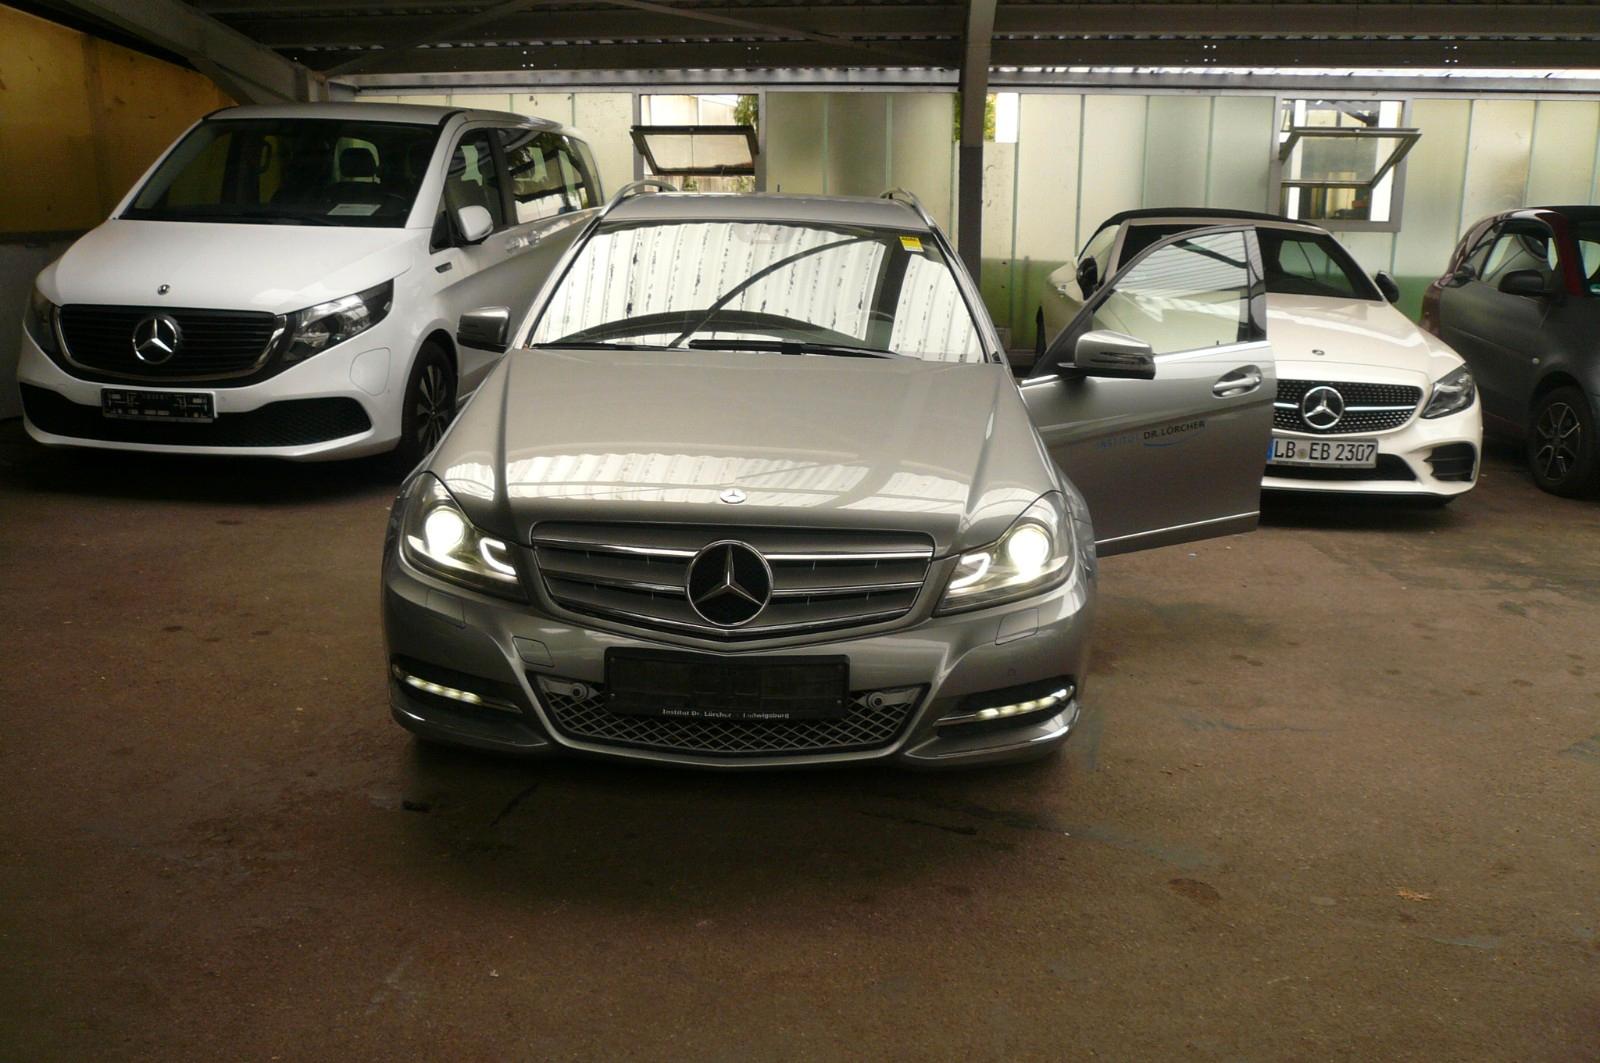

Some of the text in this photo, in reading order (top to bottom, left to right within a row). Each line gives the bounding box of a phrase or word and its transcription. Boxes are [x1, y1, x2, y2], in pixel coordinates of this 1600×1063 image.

[1161, 420, 1206, 436] LÖRCHER
[1274, 440, 1376, 462] LB EB 2307
